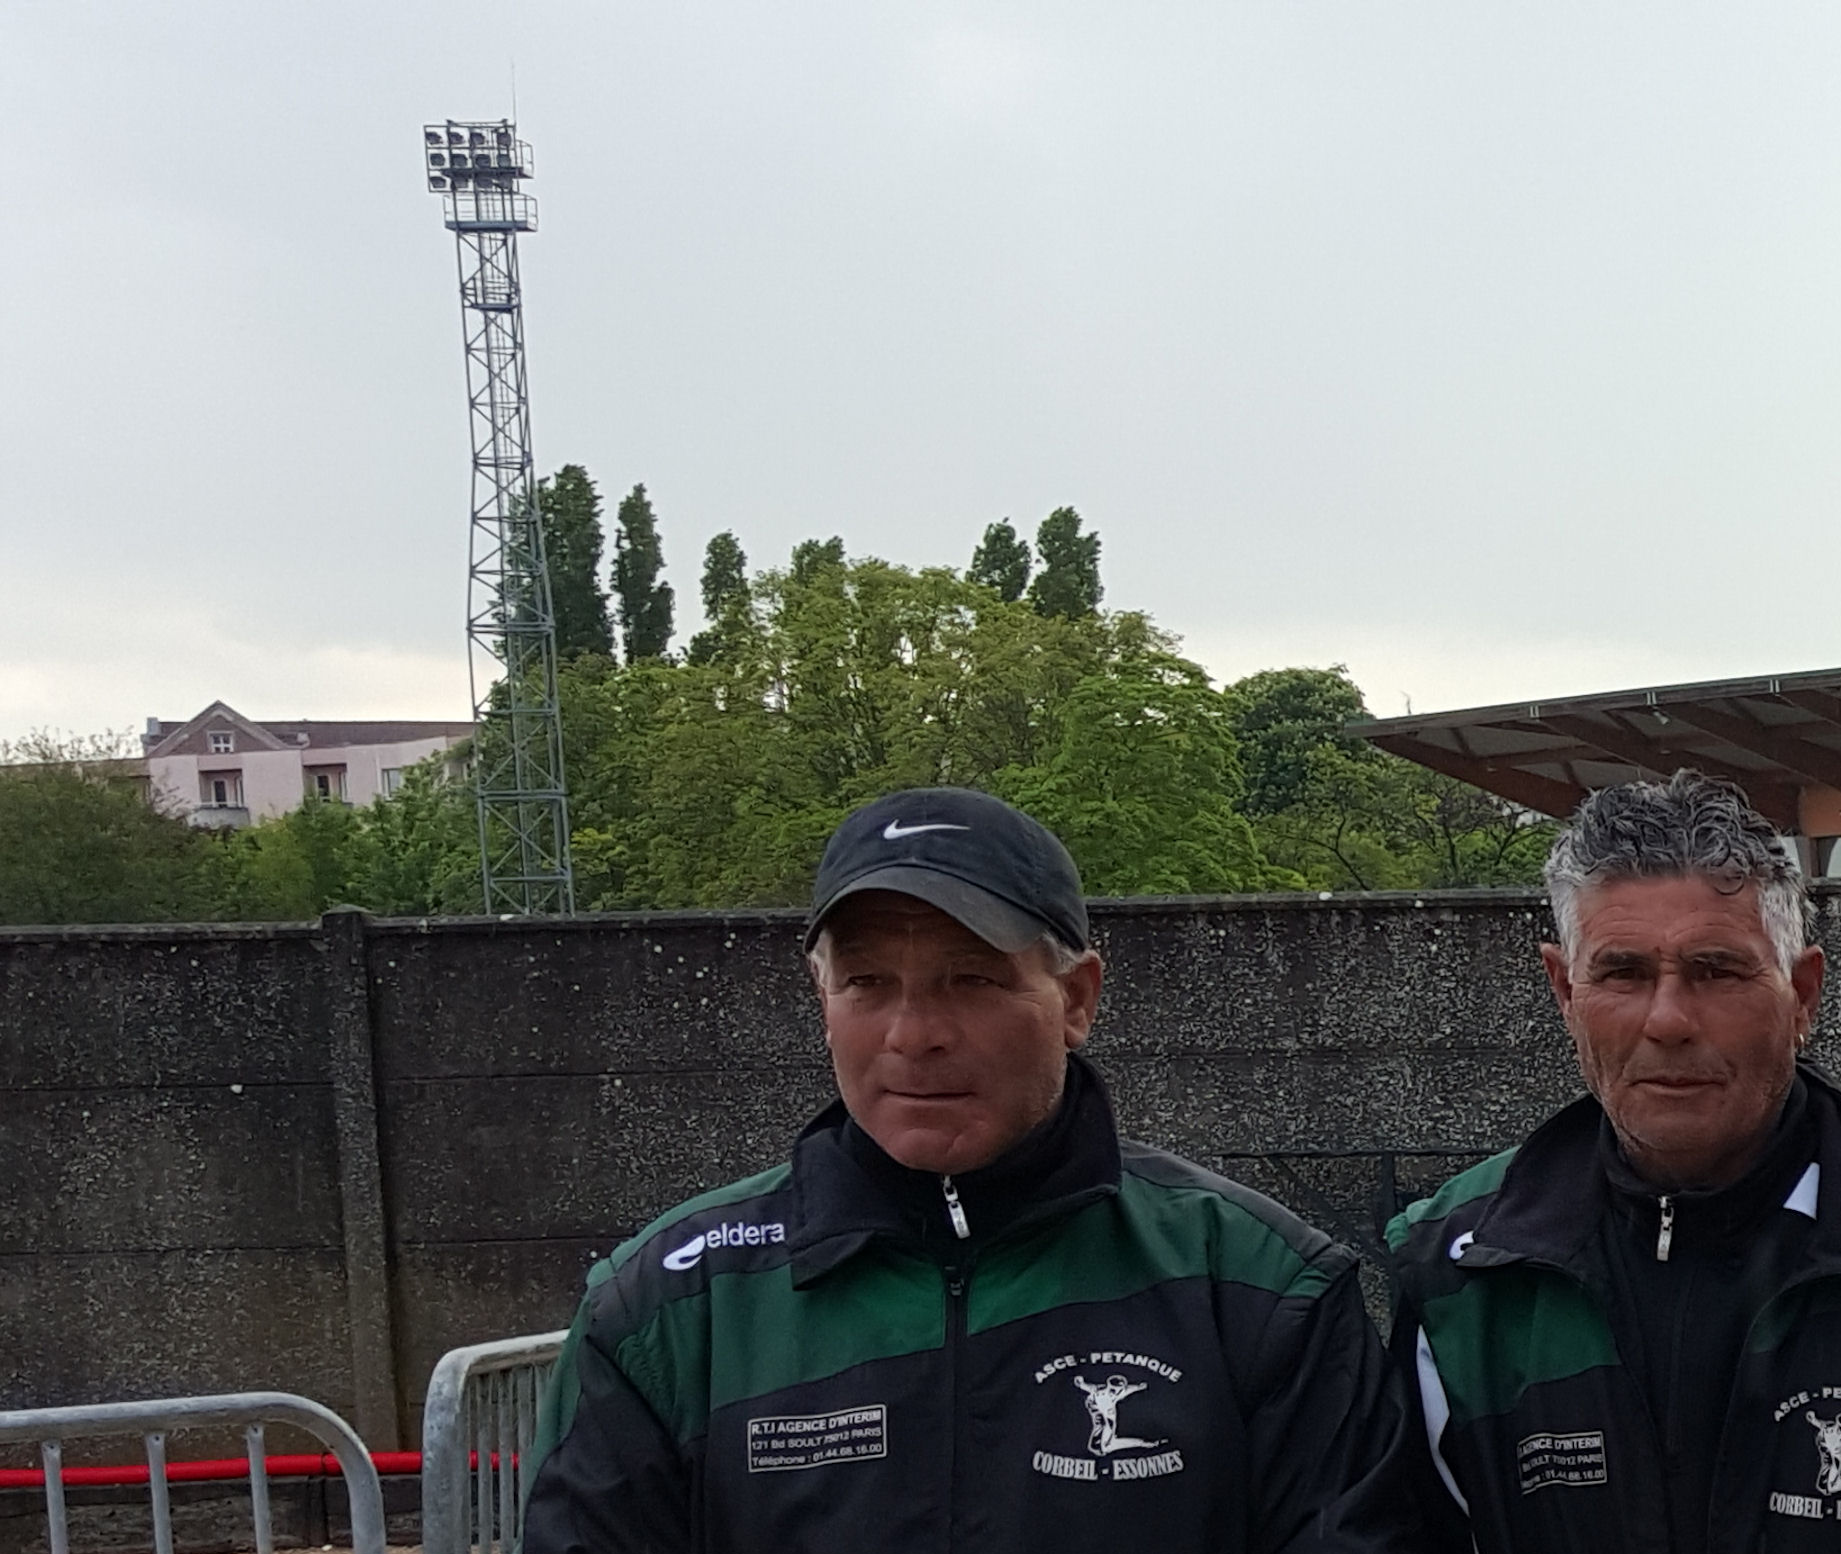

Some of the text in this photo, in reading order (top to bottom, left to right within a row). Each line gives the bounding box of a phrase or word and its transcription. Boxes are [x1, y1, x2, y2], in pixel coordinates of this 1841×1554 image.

[706, 1221, 785, 1249] eldera
[1034, 1355, 1077, 1384] ASCE
[1090, 1352, 1183, 1383] PETANQUE
[1774, 1391, 1811, 1422] ASCE
[777, 1419, 827, 1433] AGENCE
[1032, 1450, 1098, 1481] CORBEIL
[1112, 1450, 1184, 1481] ESSONNES
[1769, 1491, 1823, 1519] CORBEIL
